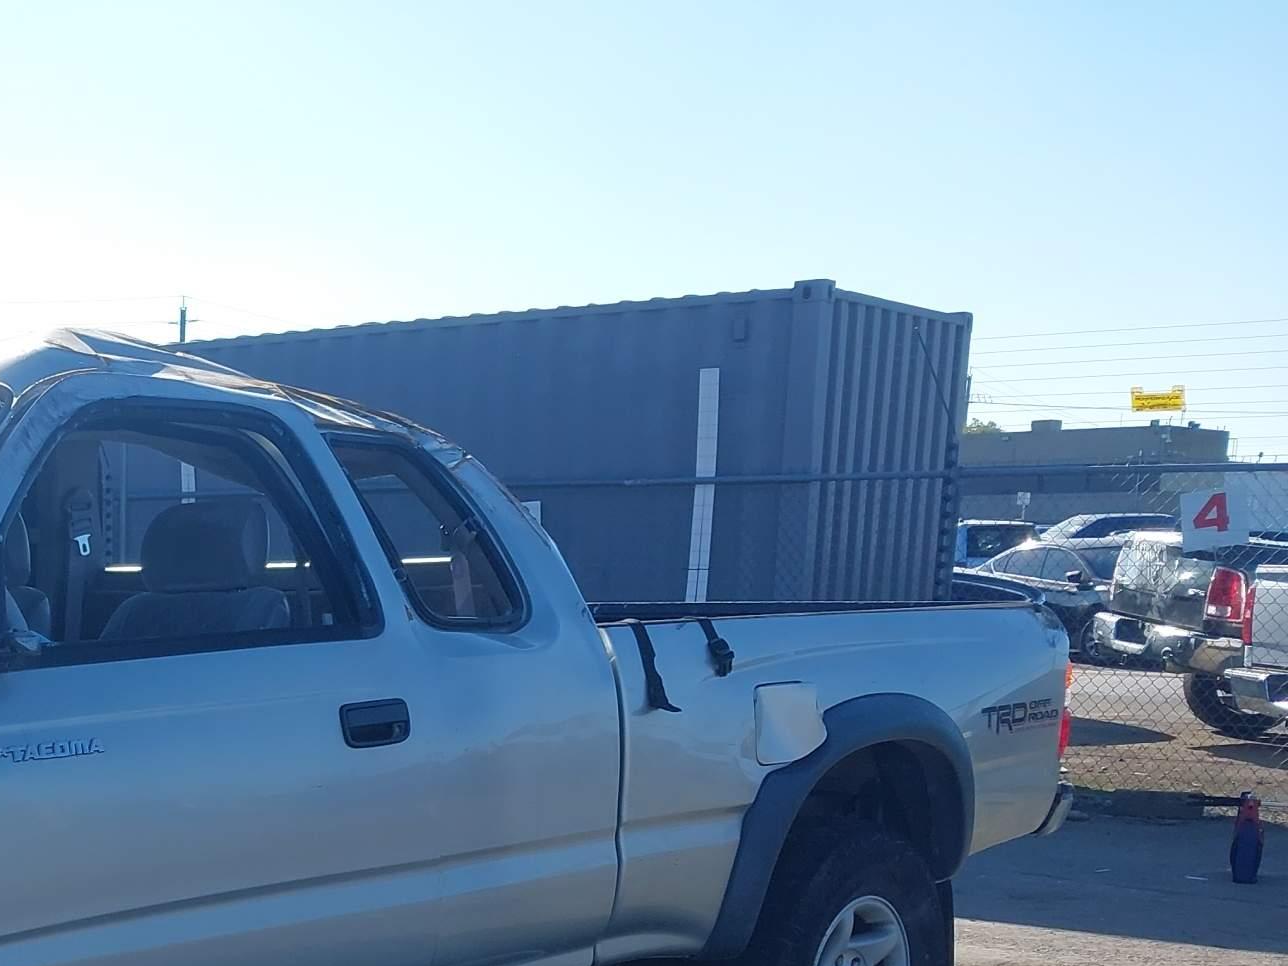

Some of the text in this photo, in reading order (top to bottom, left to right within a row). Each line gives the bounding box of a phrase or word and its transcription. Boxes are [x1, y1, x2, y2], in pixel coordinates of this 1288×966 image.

[1193, 492, 1230, 532] 4
[1028, 698, 1053, 710] OFF
[1028, 709, 1059, 722] ROAD
[981, 702, 1028, 735] TRD
[8, 738, 105, 763] TACOMA
